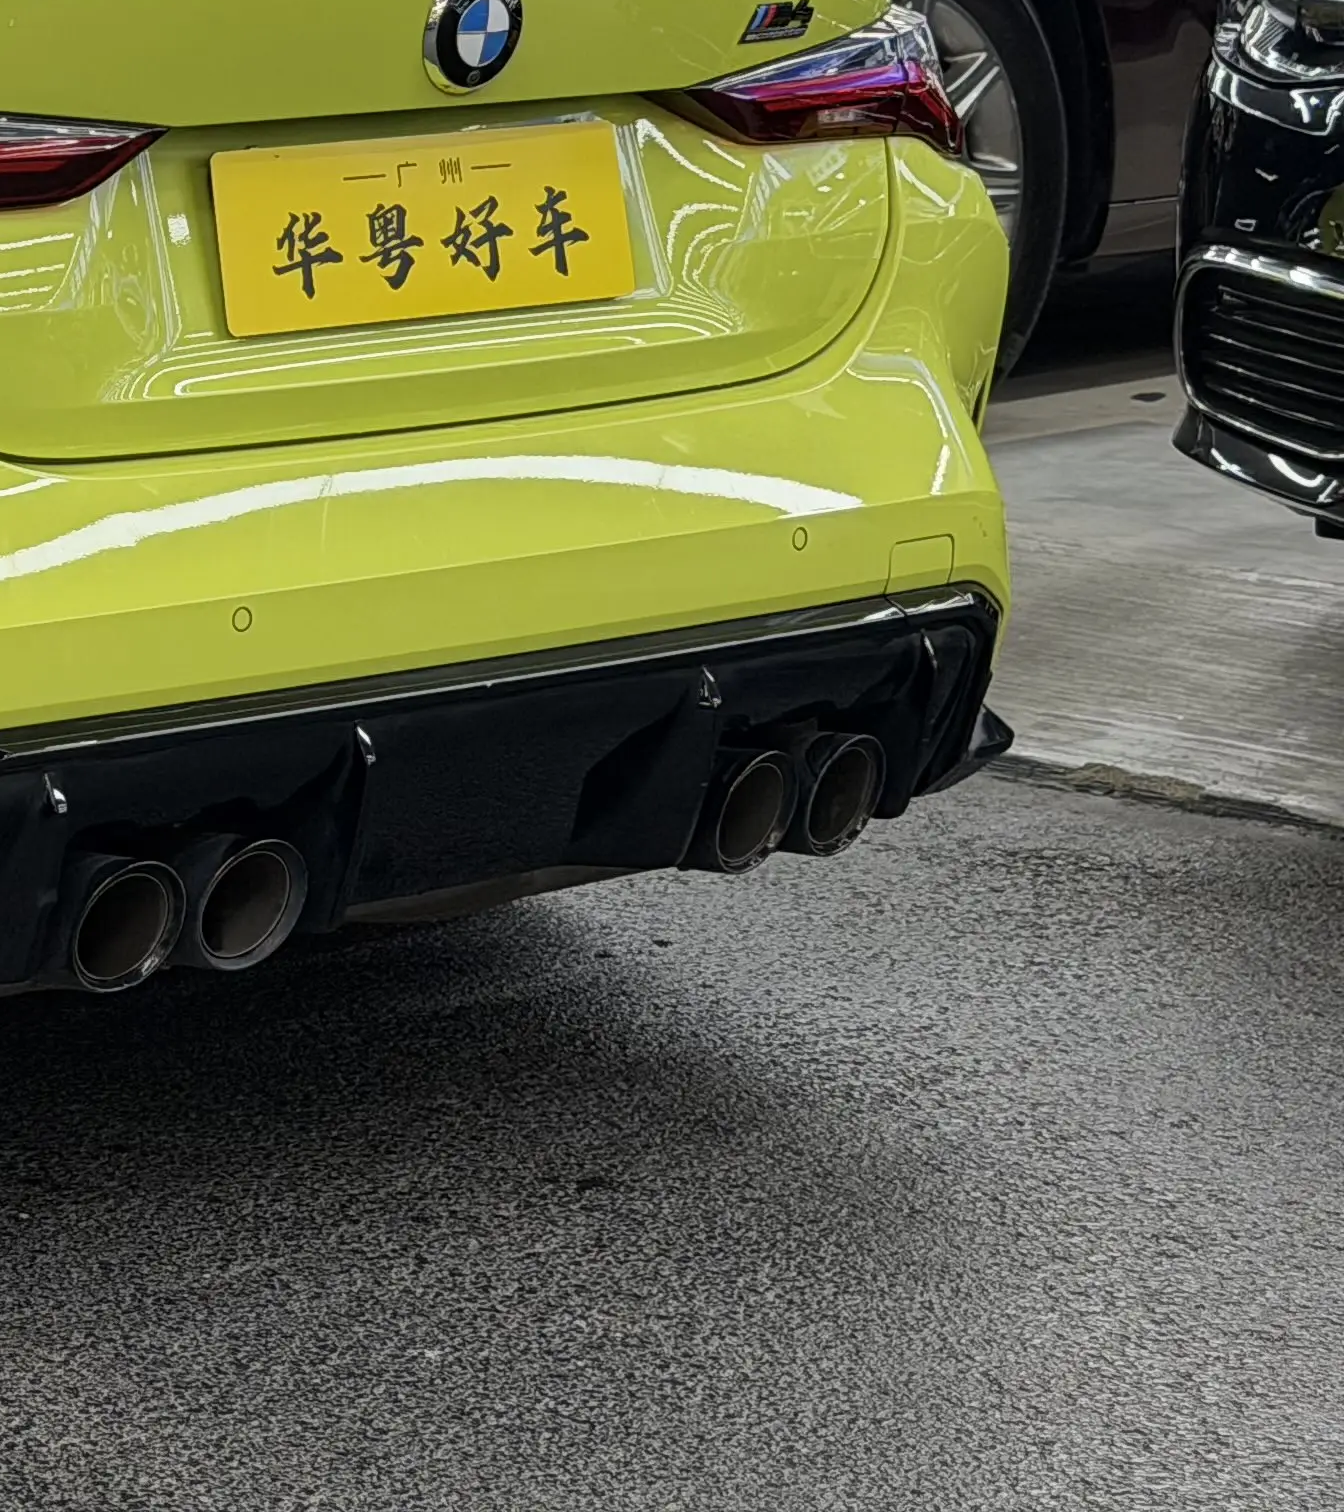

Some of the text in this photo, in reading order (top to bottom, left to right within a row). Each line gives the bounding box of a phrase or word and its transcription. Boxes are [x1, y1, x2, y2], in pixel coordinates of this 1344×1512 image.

[396, 156, 464, 189] 广州
[272, 185, 591, 300] 华粤好车
